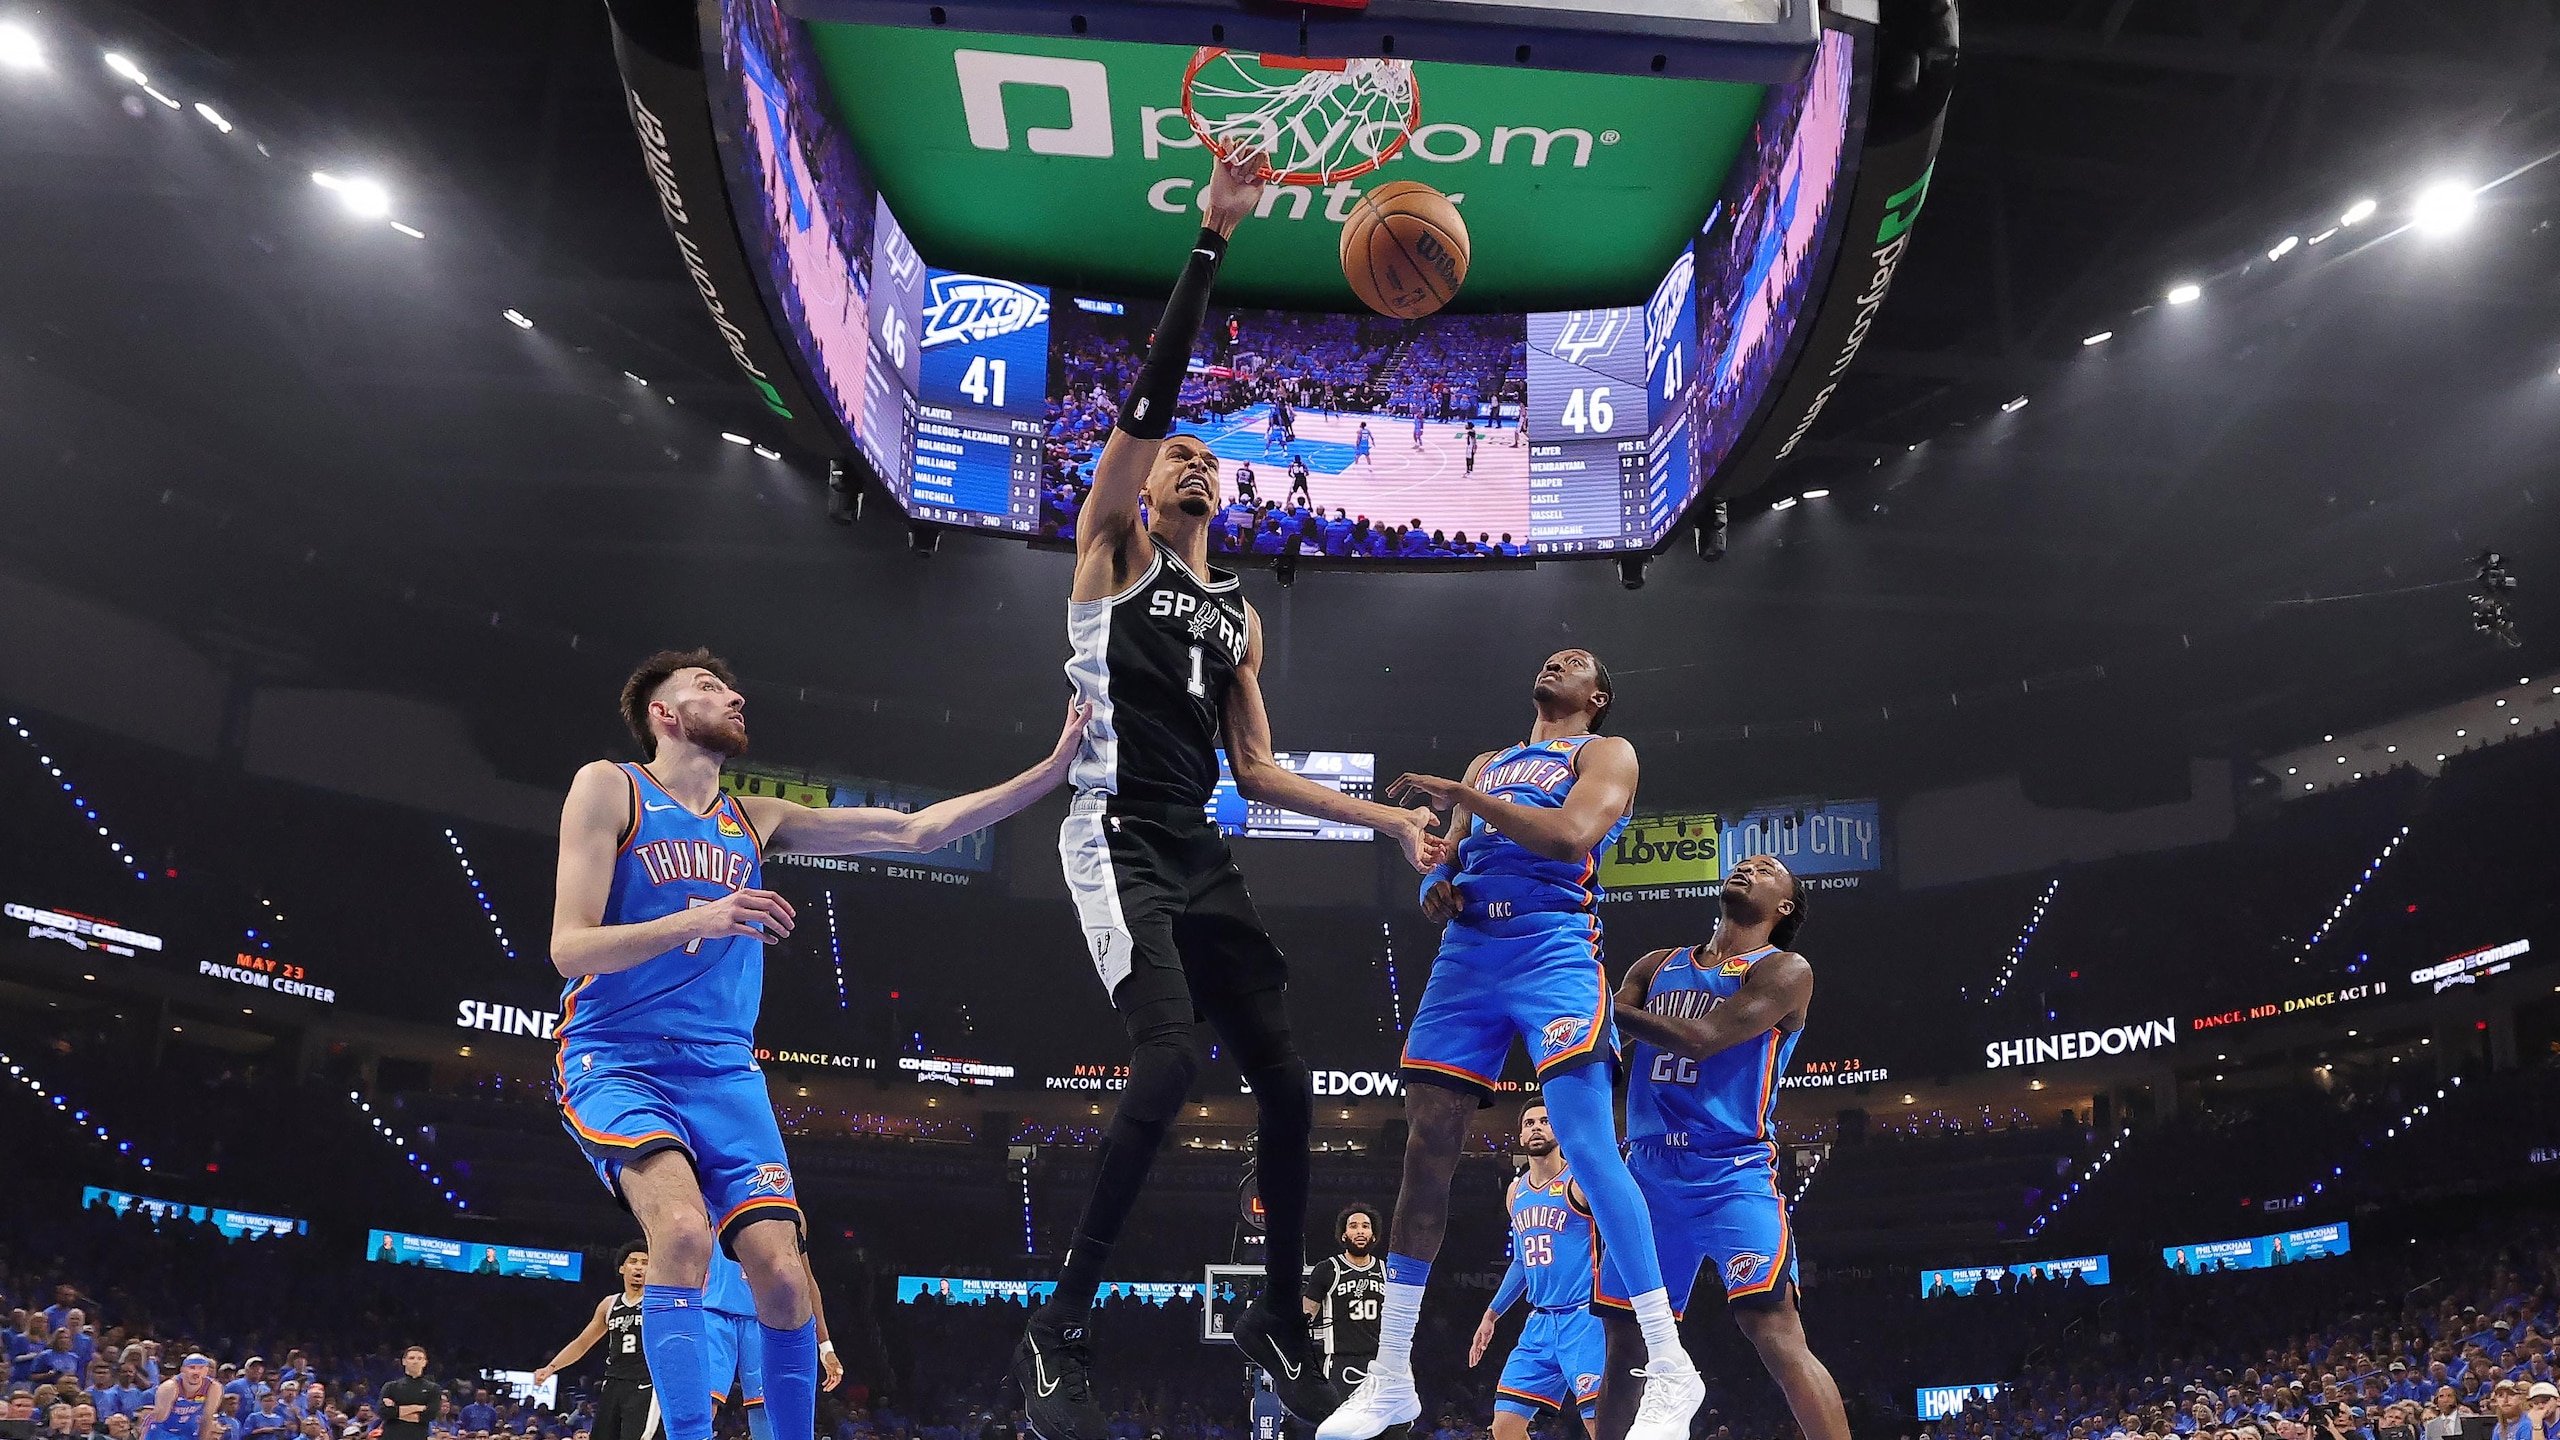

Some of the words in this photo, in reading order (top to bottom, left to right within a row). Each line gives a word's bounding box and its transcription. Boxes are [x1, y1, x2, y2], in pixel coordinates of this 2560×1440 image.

[1147, 177, 1465, 222] cnt
[675, 231, 767, 380] paycom
[1829, 234, 1907, 377] paycom
[882, 303, 907, 370] 46
[960, 355, 1007, 407] 41
[1663, 341, 1683, 401] 41
[920, 405, 953, 421] PLAYER
[1011, 420, 1028, 432] PTS
[1030, 422, 1041, 434] FL
[1561, 386, 1615, 434] 46
[917, 422, 1010, 446] GILGEOUS-ALEXANDER
[1015, 437, 1023, 448] 4
[1031, 439, 1037, 449] 0
[1531, 446, 1562, 456] PLAYER
[1617, 441, 1634, 452] PTS
[1635, 440, 1646, 451] FL
[916, 438, 964, 455] HOLMGREN
[1015, 453, 1022, 464] 2
[1031, 455, 1036, 466] 1
[1530, 461, 1587, 472] WEMBANYAMA
[1621, 457, 1632, 467] 12
[1637, 456, 1644, 467] 0
[915, 455, 958, 471] WILLIAMS
[1013, 470, 1024, 480] 12
[1030, 472, 1036, 482] 2
[1530, 478, 1563, 488] HARPER
[1624, 474, 1631, 483] 7
[1639, 472, 1645, 482] 1
[914, 471, 953, 487] WALLACE
[1013, 486, 1021, 497] 3
[1028, 488, 1035, 498] 0
[1531, 494, 1560, 504] CASTLE
[1622, 489, 1633, 499] 11
[1639, 488, 1645, 498] 1
[913, 488, 956, 505] MITCHELL
[1012, 502, 1020, 513] 0
[1027, 504, 1034, 515] 2
[1531, 510, 1564, 520] VASSELL
[1624, 506, 1632, 516] 2
[1638, 505, 1646, 514] 0
[918, 506, 931, 518] TO
[934, 508, 942, 519] 5
[946, 510, 958, 522] TF
[962, 513, 968, 523] 1
[982, 515, 1000, 527] 2ND
[1011, 519, 1031, 532] 1:35
[1531, 525, 1584, 537] CHAMPAGNIE
[1625, 522, 1632, 532] 3
[1640, 521, 1646, 531] 1
[1537, 543, 1549, 553] TO
[1551, 542, 1558, 552] 5
[1563, 542, 1574, 552] TF
[1577, 541, 1584, 551] 3
[1597, 540, 1615, 550] 2ND
[1625, 538, 1643, 548] 1:35
[1187, 645, 1206, 699] 1
[1315, 756, 1343, 773] 46
[1810, 814, 1873, 861] CITY
[777, 853, 860, 873] THUNDER
[887, 866, 925, 881] EXIT
[930, 871, 971, 887] NOW
[1638, 889, 1671, 901] THE
[1673, 885, 1722, 900] THUN
[1819, 877, 1860, 890] NOW
[1488, 902, 1512, 919] OKC
[236, 953, 277, 973] MAY
[282, 963, 306, 980] 23
[199, 960, 270, 989] PAYCOM
[272, 977, 336, 1004] CENTER
[2193, 1010, 2247, 1030] DANCE,
[2250, 1004, 2282, 1019] KID,
[2284, 992, 2335, 1013] DANCE
[2339, 985, 2369, 1001] ACT
[2374, 981, 2387, 994] II
[456, 999, 560, 1041] SHINE
[1985, 1016, 2177, 1070] SHINEDOWN
[754, 1048, 775, 1062] ID,
[779, 1050, 829, 1066] DANCE
[832, 1053, 860, 1068] ACT
[1074, 1064, 1106, 1077] MAY
[1113, 1065, 1131, 1077] 23
[1806, 1060, 1837, 1074] MAY
[1844, 1058, 1861, 1071] 23
[1046, 1076, 1101, 1090] PAYCOM
[1778, 1074, 1834, 1090] PAYCOM
[1837, 1068, 1888, 1085] CENTER
[1666, 1130, 1689, 1147] OKC
[1512, 1206, 1567, 1236] THUNDER
[1523, 1234, 1554, 1267] 25
[963, 1280, 981, 1289] PHIL
[981, 1280, 1027, 1290] WICKHAM
[1151, 1283, 1196, 1292] WICKAM
[1349, 1300, 1378, 1321] 30
[622, 1334, 636, 1354] 2
[1260, 1416, 1274, 1428] GET
[1260, 1428, 1274, 1440] THE
